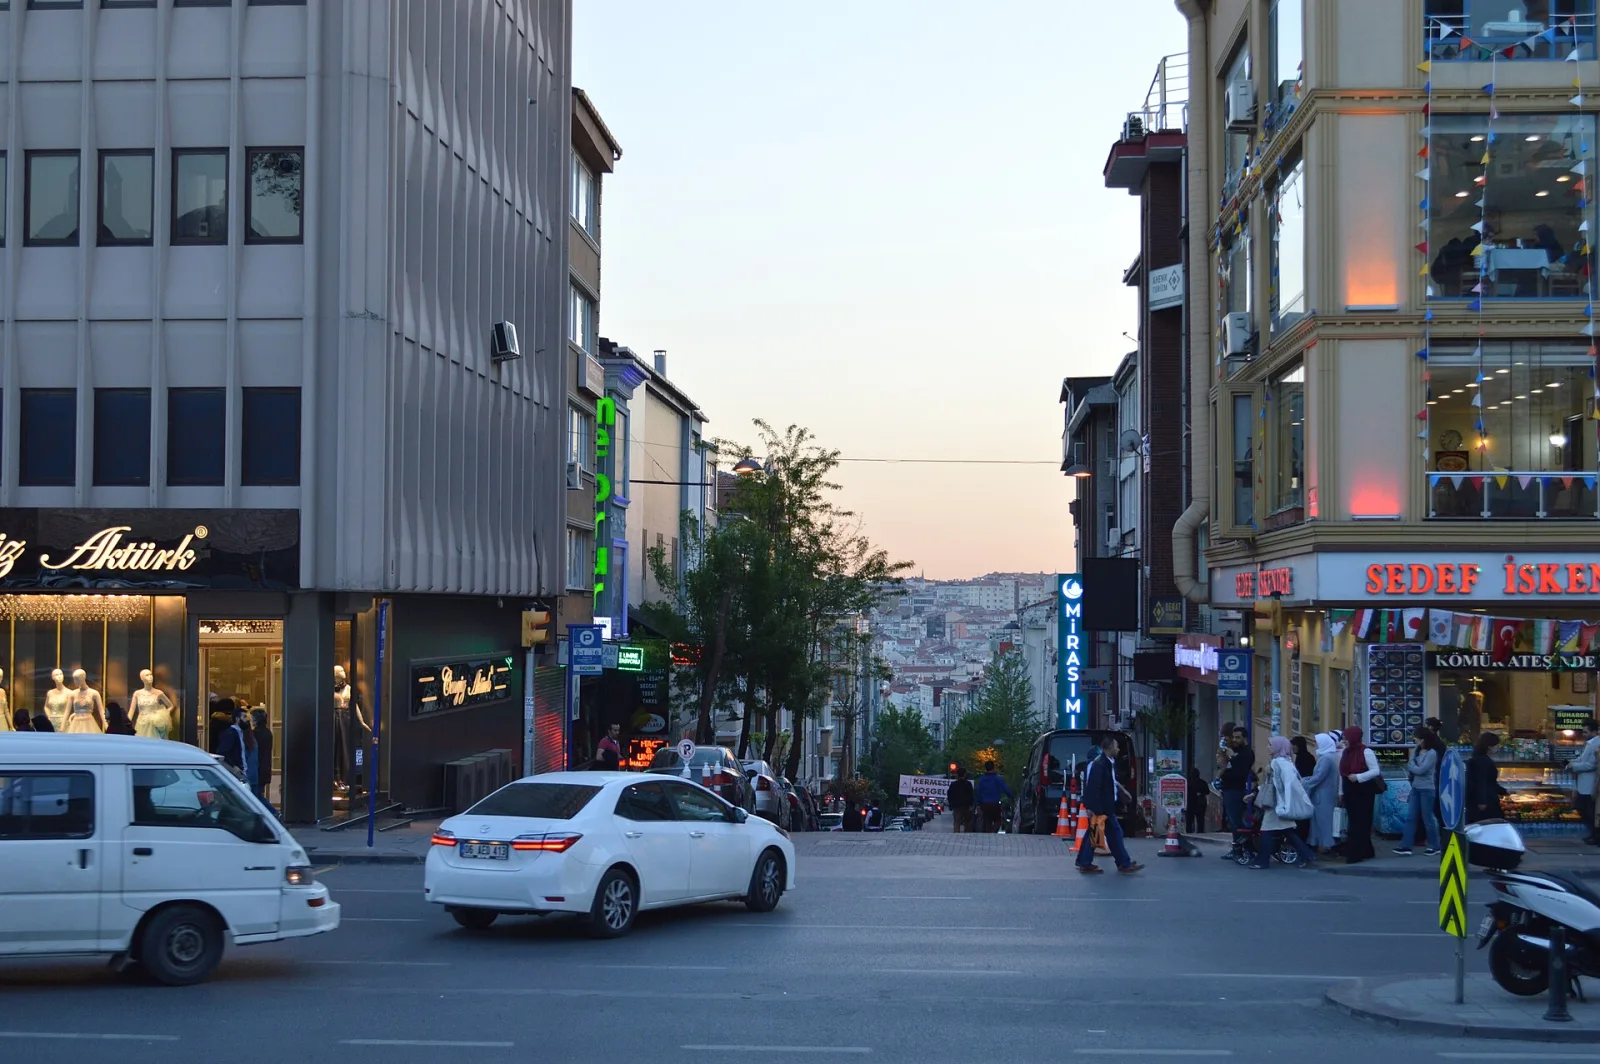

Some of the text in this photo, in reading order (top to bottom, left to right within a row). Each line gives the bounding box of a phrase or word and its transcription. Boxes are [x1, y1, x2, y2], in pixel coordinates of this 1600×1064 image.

[1366, 563, 1480, 594] SEDEF
[1436, 652, 1596, 669] KÖMÜ ATEŞNDE
[911, 787, 946, 795] HOŞGEL
